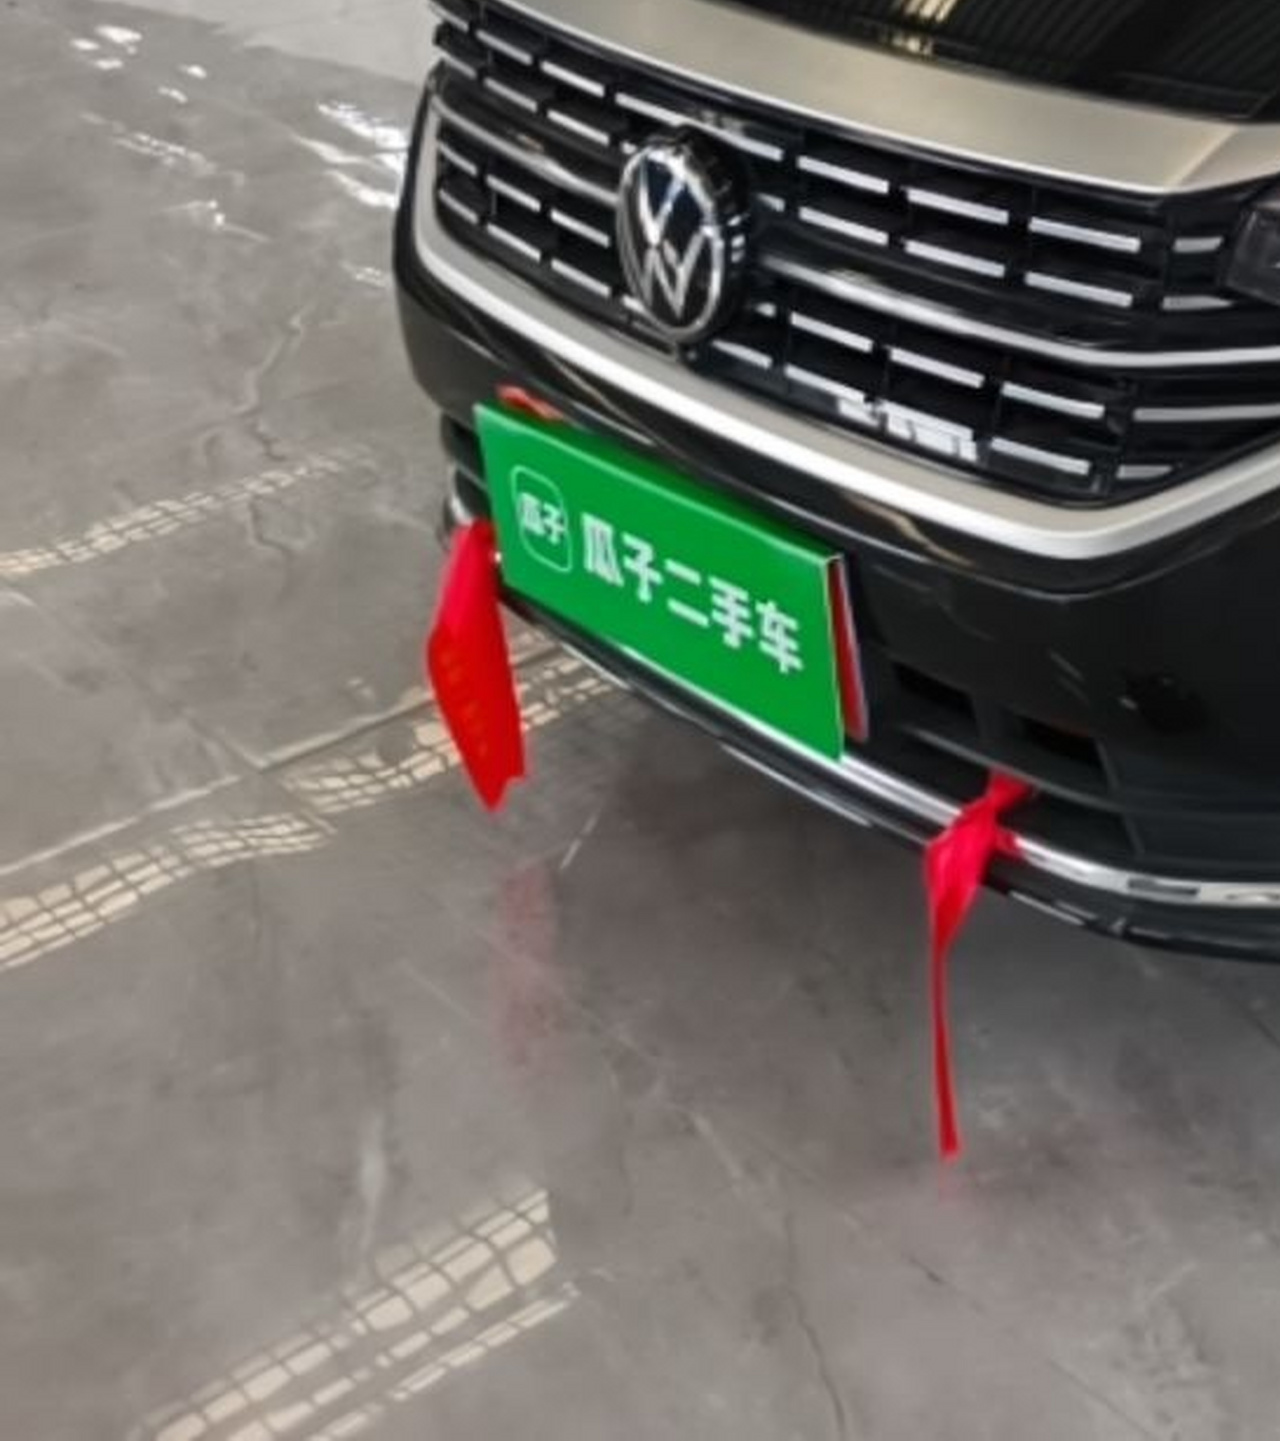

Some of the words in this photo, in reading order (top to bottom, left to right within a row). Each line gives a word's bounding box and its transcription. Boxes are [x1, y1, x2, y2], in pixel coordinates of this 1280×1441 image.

[519, 492, 567, 545] 瓜子
[581, 512, 804, 674] 瓜子二手车
